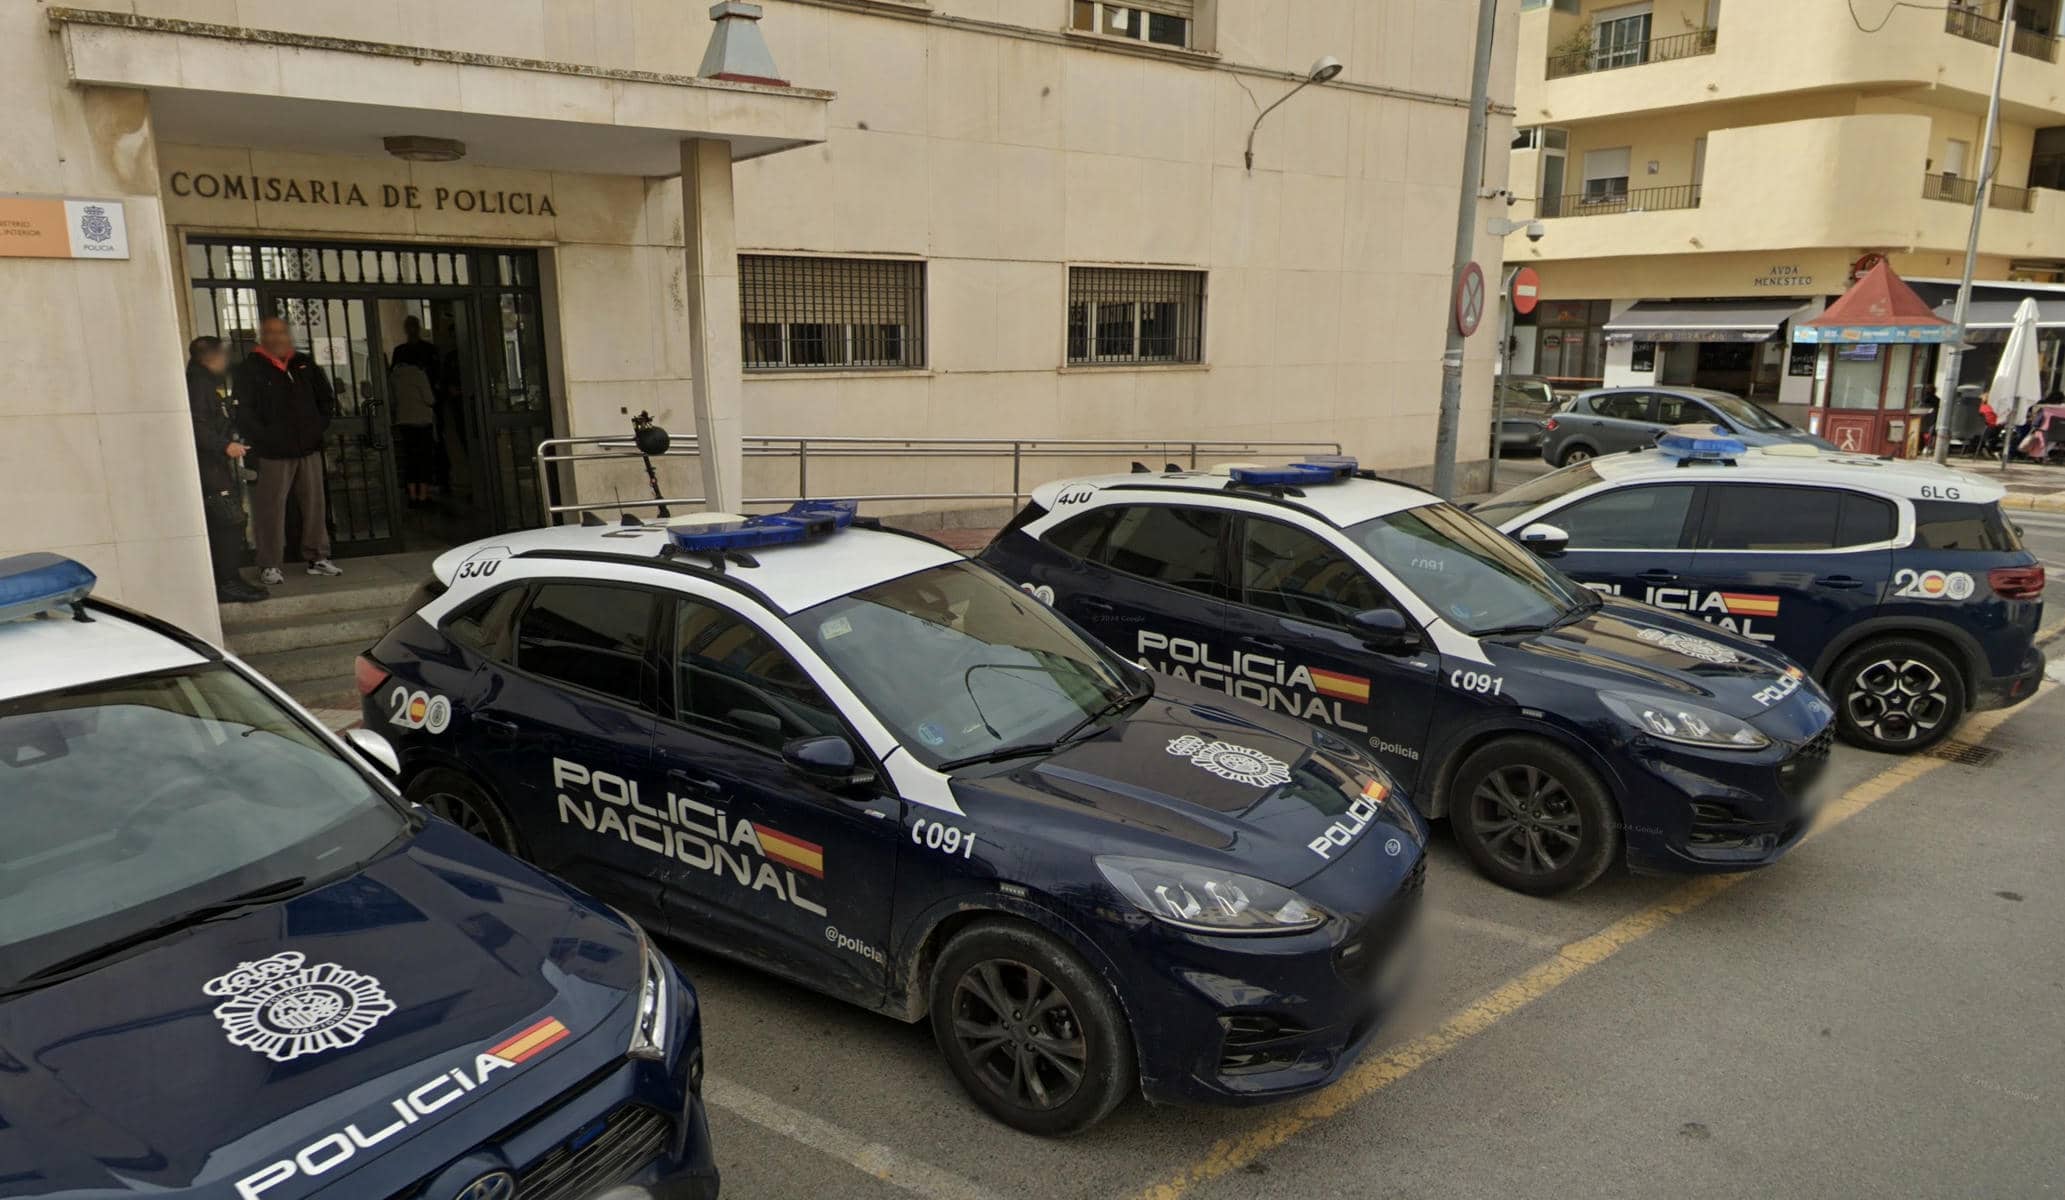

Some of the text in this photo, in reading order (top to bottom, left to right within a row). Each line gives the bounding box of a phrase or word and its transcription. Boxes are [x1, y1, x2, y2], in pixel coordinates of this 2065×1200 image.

[170, 171, 558, 217] COMISARIA DE POLICIA
[1058, 491, 1093, 505] 4JU
[1920, 485, 1960, 500] 6LG
[459, 559, 502, 579] 3JU
[1368, 736, 1420, 761] @policia
[557, 793, 828, 918] NACIONAL
[825, 925, 885, 964] @policia
